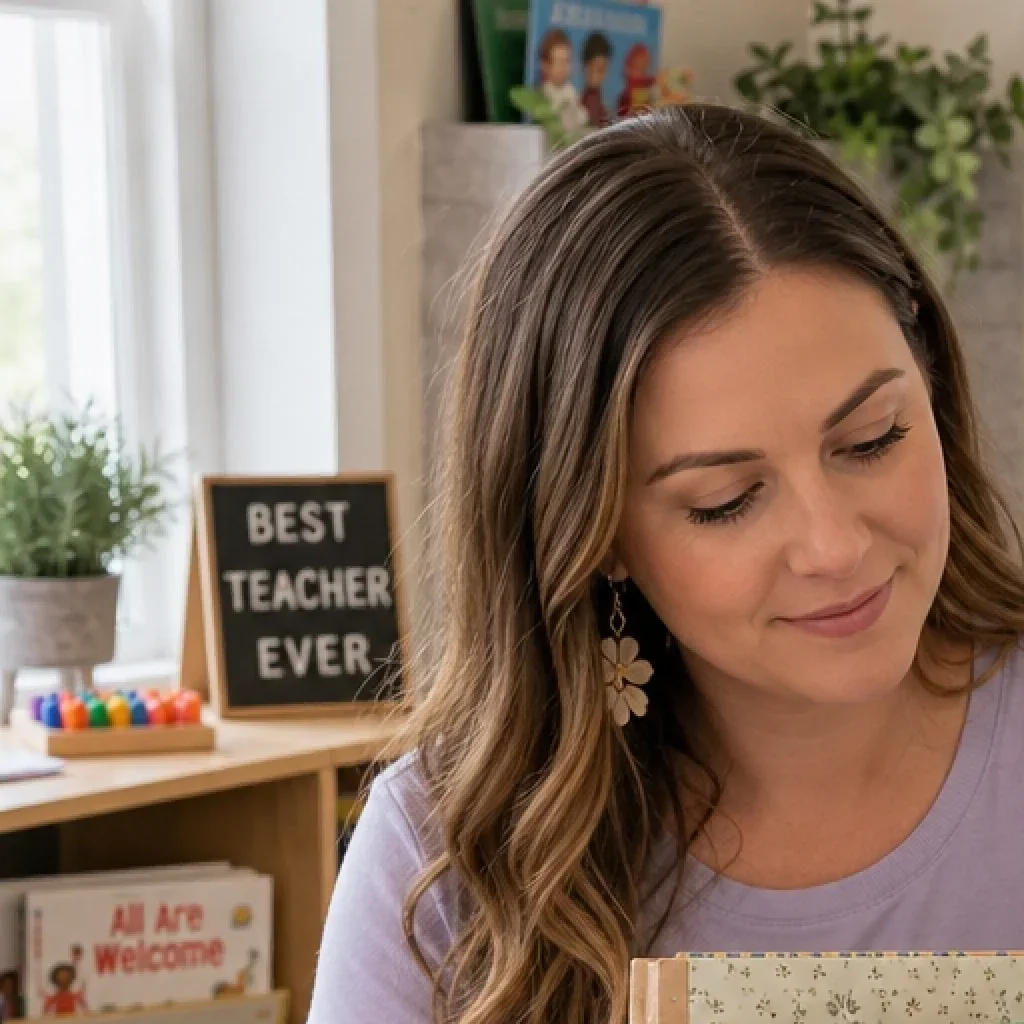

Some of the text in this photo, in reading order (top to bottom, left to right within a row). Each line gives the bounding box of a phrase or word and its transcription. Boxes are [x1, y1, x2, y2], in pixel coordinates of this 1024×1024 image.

[247, 501, 350, 545] BEST
[224, 566, 392, 613] TEACHER
[257, 633, 371, 680] EVER
[110, 902, 204, 936] All Are
[94, 938, 225, 975] Welcome
